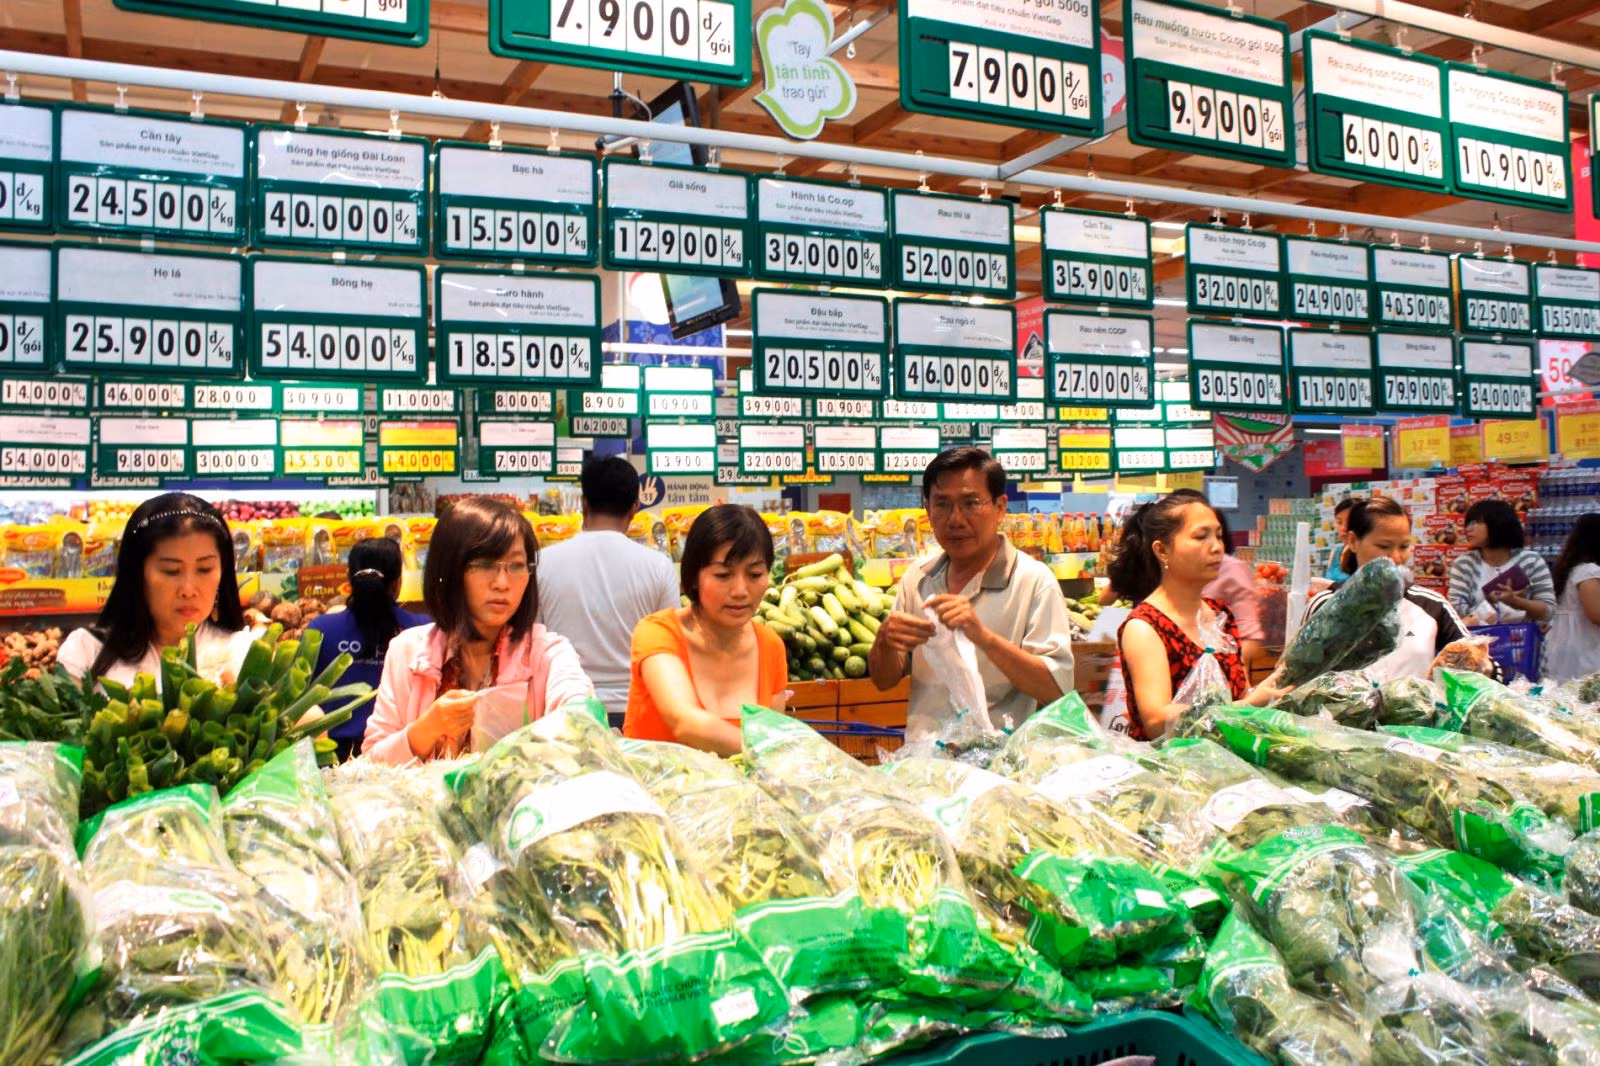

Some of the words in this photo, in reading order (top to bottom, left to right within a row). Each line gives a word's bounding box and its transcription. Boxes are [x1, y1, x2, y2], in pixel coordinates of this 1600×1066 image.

[1134, 13, 1153, 27] Rau
[952, 50, 1056, 103] 7.900
[782, 85, 805, 99] trao
[1171, 90, 1257, 137] 9.900
[1346, 123, 1419, 165] 6.000
[381, 153, 406, 164] Loan
[1462, 145, 1544, 186] 10.900
[73, 183, 204, 222] 24.500
[270, 200, 388, 234] 40.000
[452, 214, 560, 246] 15.500
[620, 226, 717, 258] 12.900
[769, 238, 858, 270] 39.000
[906, 250, 987, 281] 52.000
[1056, 264, 1128, 292] 35.900
[521, 288, 544, 299] hành
[1198, 278, 1263, 305] 32.000
[1297, 287, 1354, 312] 24.900
[1385, 293, 1436, 318] 40.500
[1469, 302, 1518, 324] 22.500
[1544, 308, 1591, 329] 15.500
[72, 322, 201, 357] 25.900
[266, 329, 387, 362] 54.000
[454, 340, 564, 369] 18.500
[768, 354, 859, 382] 20.500
[908, 360, 989, 388] 46.000
[1058, 369, 1130, 394] 27.000
[1201, 374, 1265, 399] 30.500
[1302, 380, 1357, 403] 11.900
[1386, 379, 1440, 401] 79.900
[1471, 387, 1521, 408] 34.000
